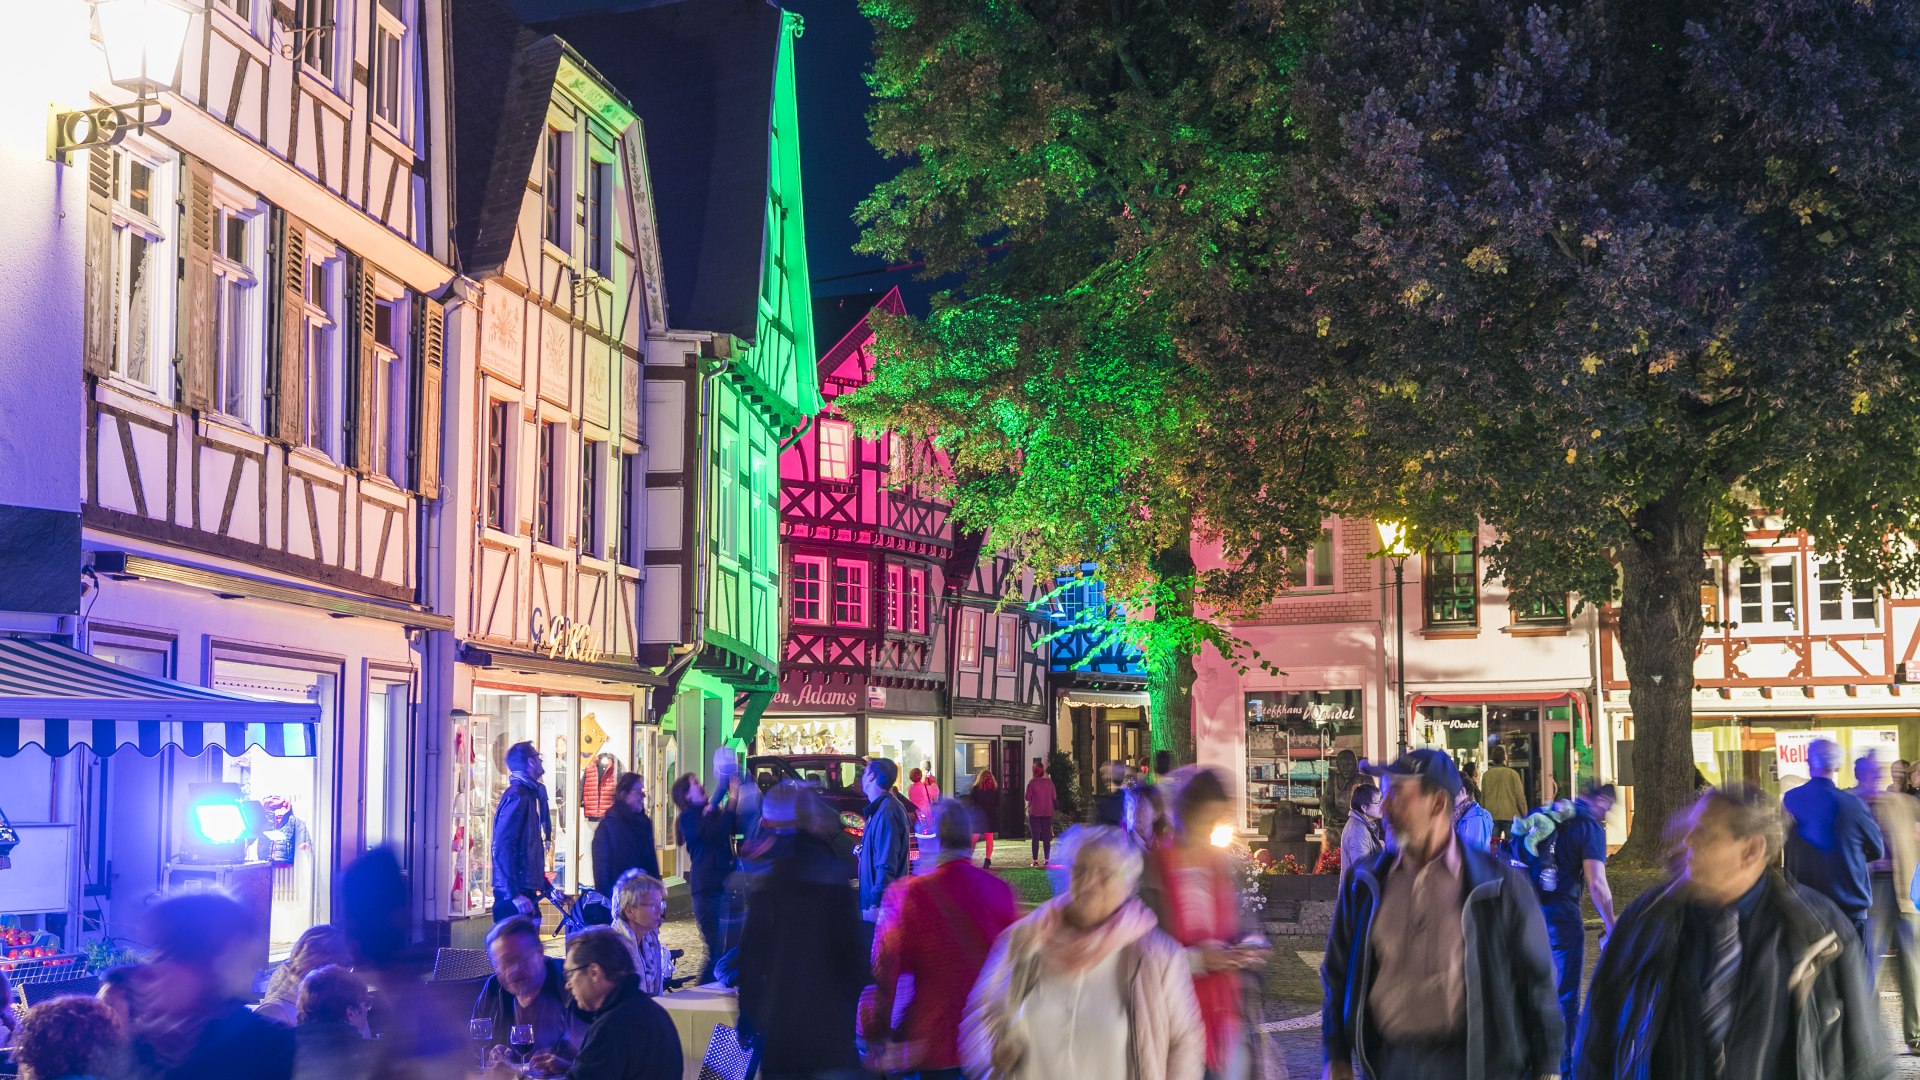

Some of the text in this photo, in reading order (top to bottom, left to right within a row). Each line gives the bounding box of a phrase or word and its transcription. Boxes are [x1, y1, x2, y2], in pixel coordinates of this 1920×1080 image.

[792, 684, 857, 707] Adams
[1303, 705, 1356, 720] Wendel
[1450, 719, 1480, 729] Wendel
[1616, 720, 1623, 729] 7
